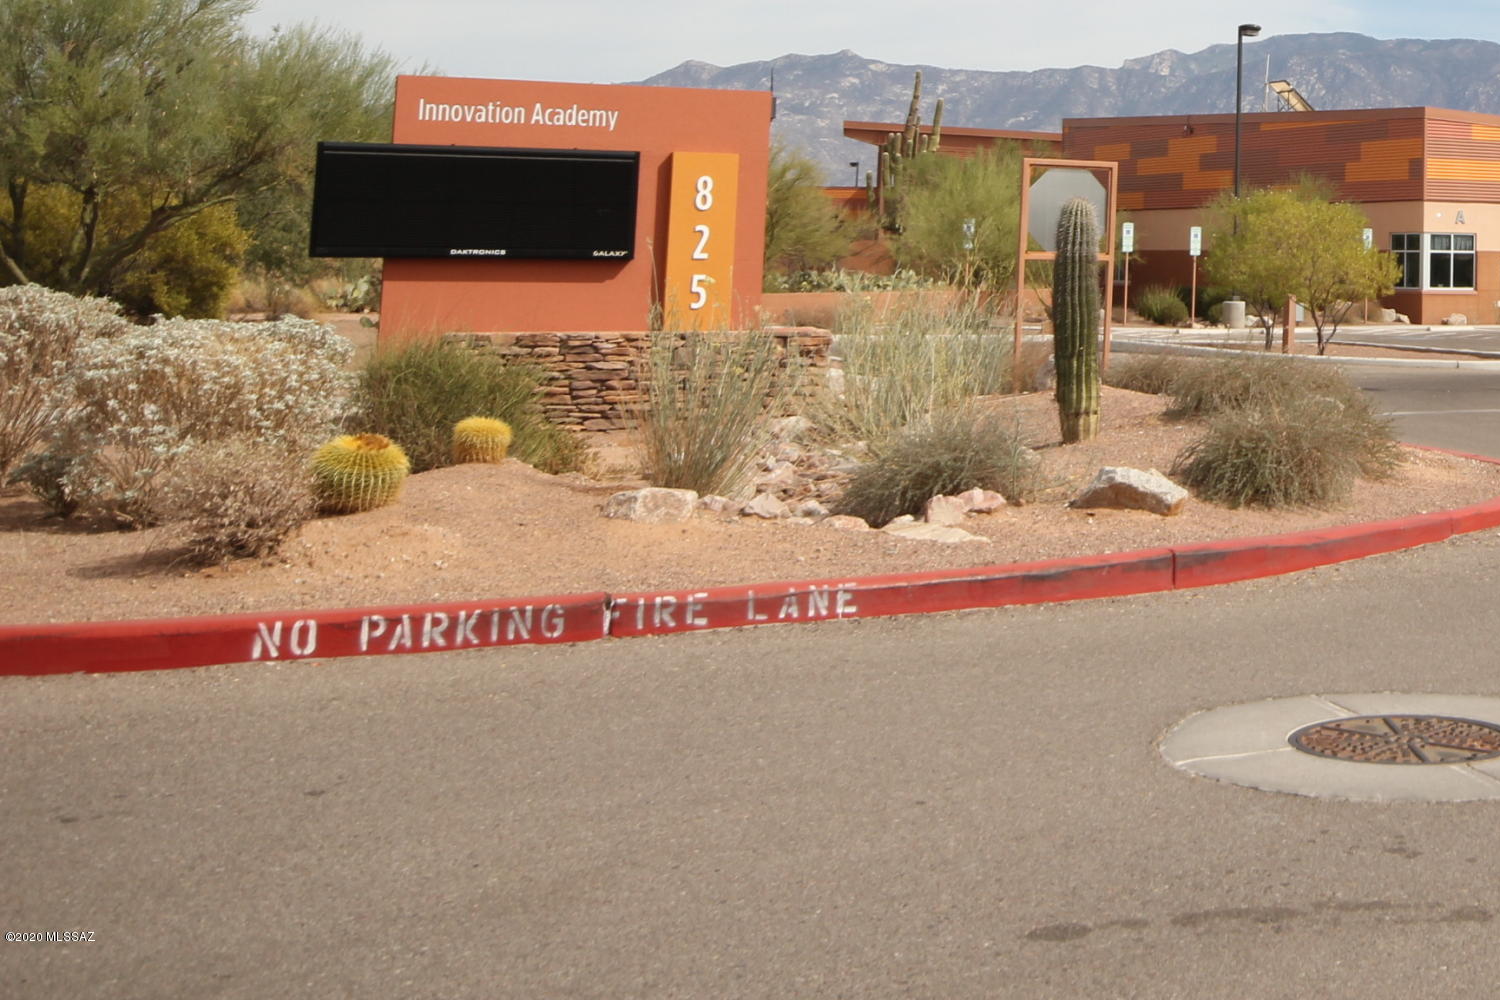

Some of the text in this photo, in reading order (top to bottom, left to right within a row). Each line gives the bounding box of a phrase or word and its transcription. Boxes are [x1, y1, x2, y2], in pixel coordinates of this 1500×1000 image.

[418, 98, 619, 132] Innovation Academy
[1455, 208, 1466, 225] A
[251, 582, 859, 660] NO PARKING FIRE LANE
